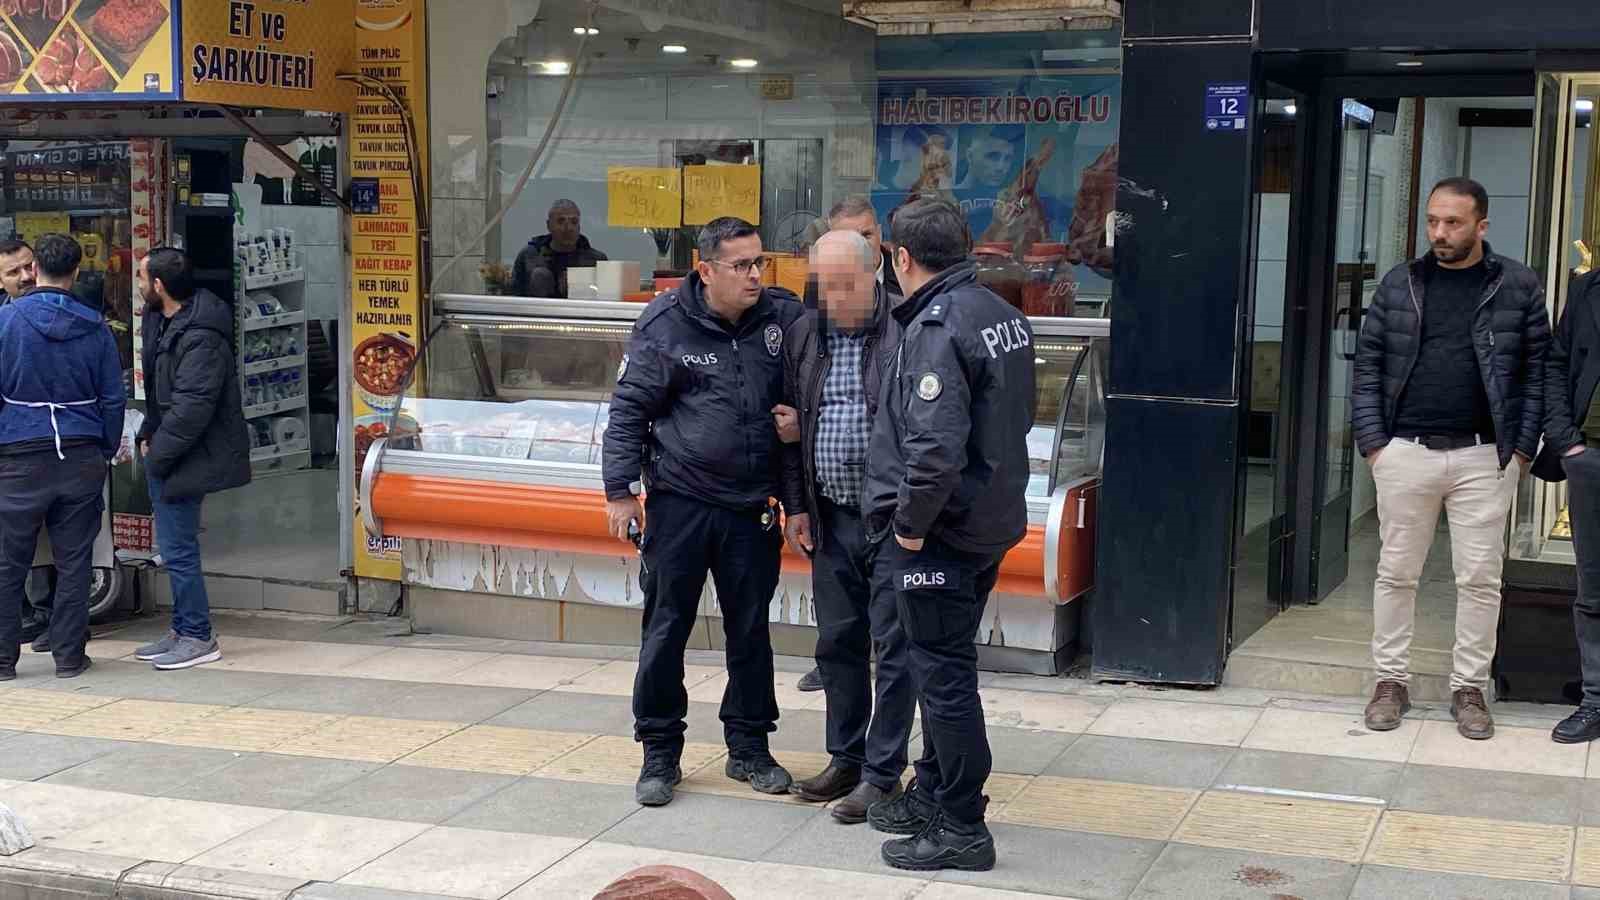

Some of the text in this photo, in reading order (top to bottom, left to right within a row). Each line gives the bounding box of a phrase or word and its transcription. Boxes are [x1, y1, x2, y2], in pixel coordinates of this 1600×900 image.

[229, 1, 286, 41] ET ve
[192, 44, 314, 89] ŞARKÜTERİ
[386, 66, 401, 77] BUT
[356, 104, 380, 115] TAVUK
[1220, 98, 1239, 114] 12
[357, 123, 381, 134] TAVUK
[359, 141, 383, 153] TAVUK
[353, 160, 378, 172] TAVUK
[358, 221, 409, 233] LAHMACUN
[371, 236, 396, 251] TEPSİ
[383, 257, 412, 271] KEBAP
[358, 277, 409, 293] HER TÜRLÜ
[367, 295, 400, 309] YEMEK
[356, 312, 413, 326] HAZIRLANIR
[367, 536, 401, 553] erpili
